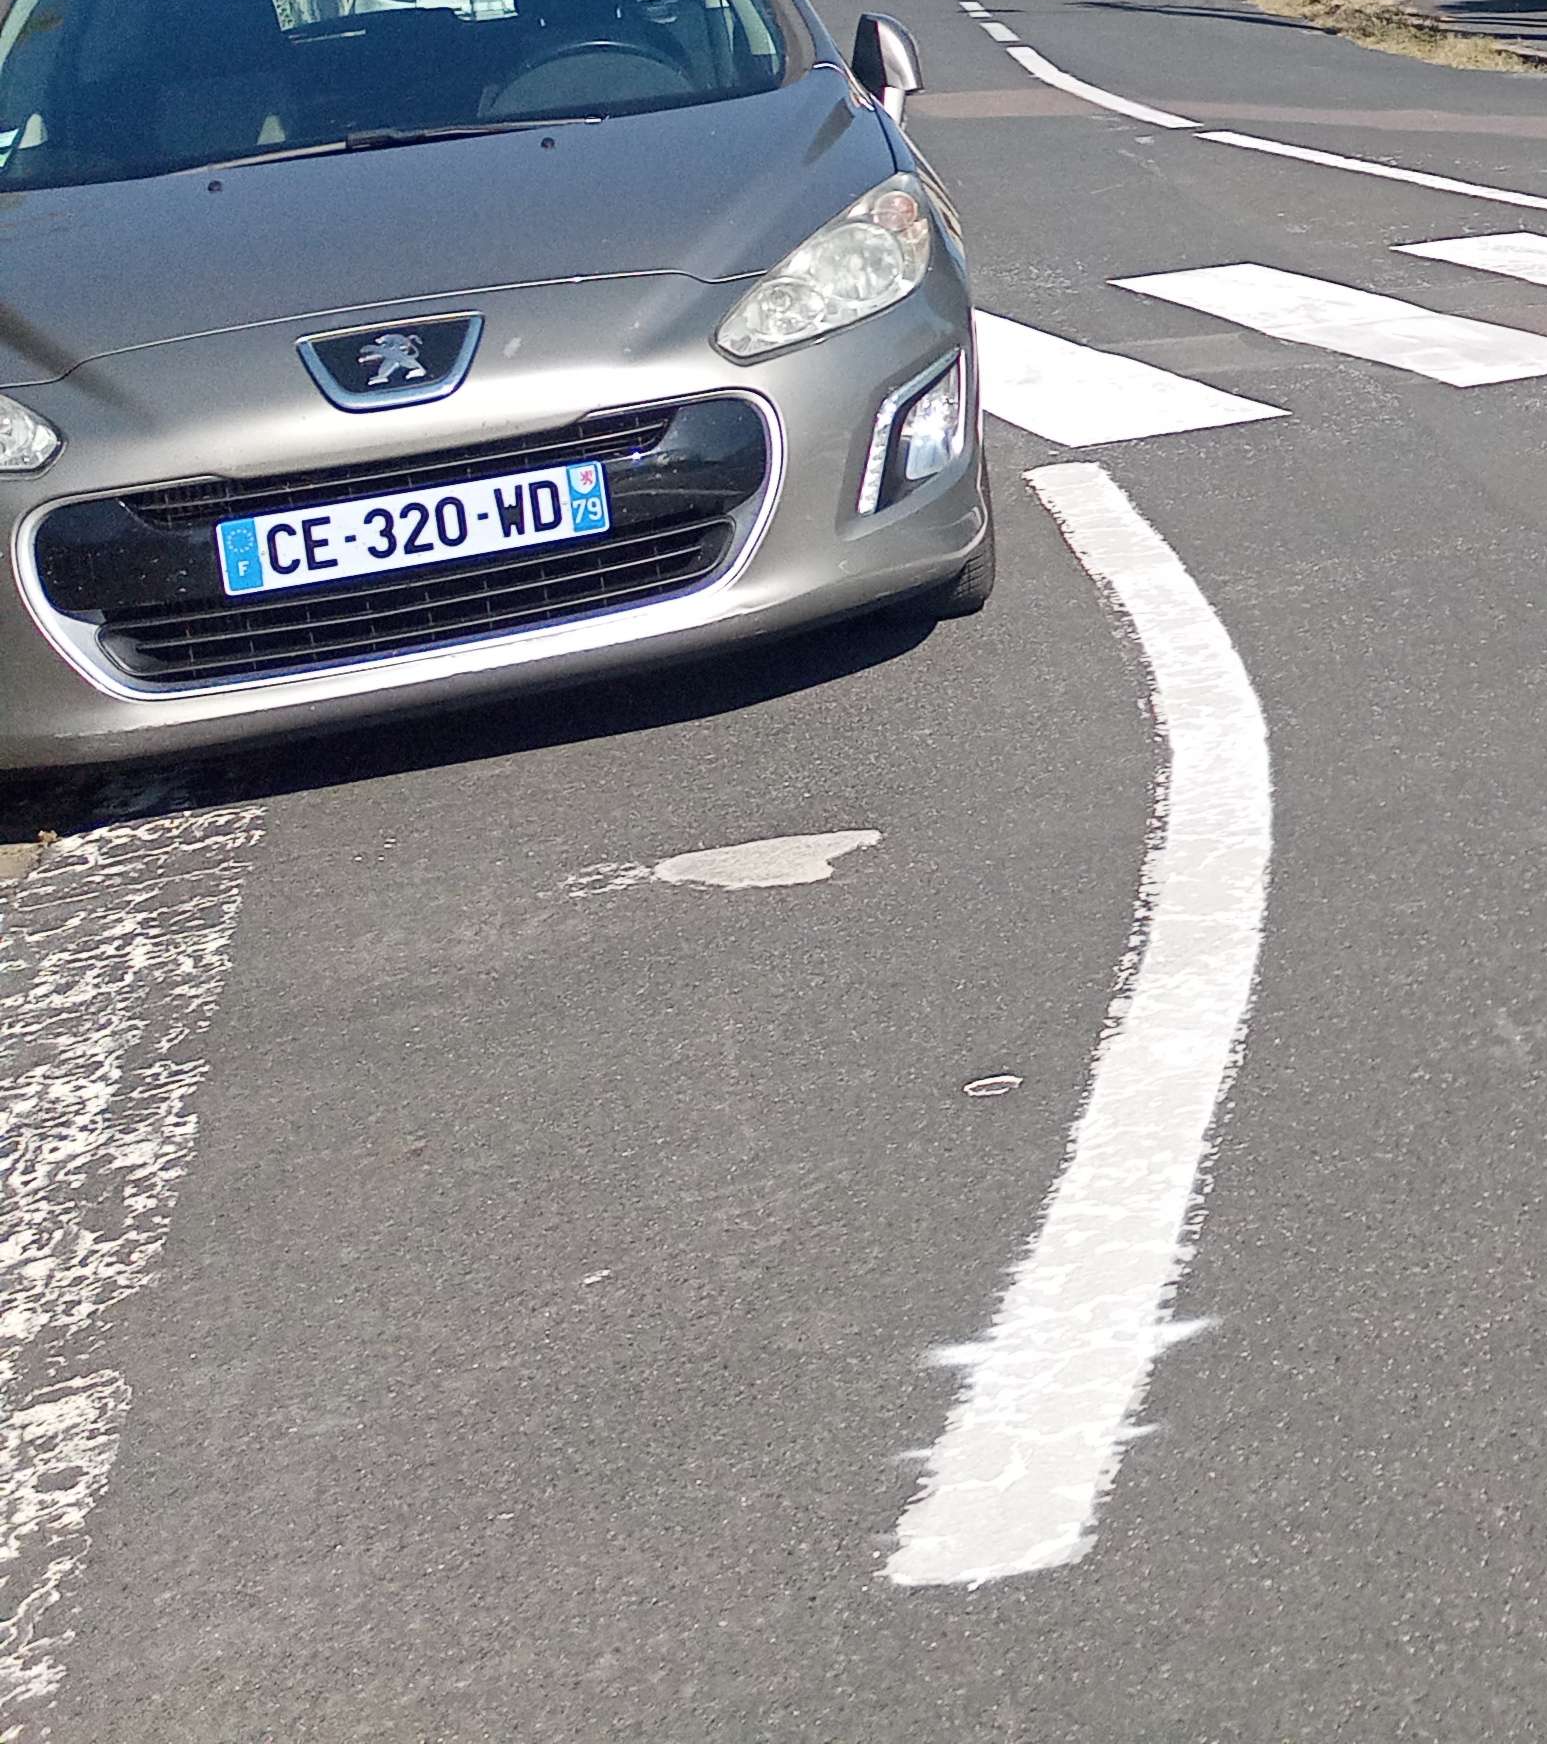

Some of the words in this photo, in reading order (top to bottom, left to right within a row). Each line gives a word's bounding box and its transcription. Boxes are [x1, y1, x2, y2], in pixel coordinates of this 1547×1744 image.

[237, 561, 250, 577] F
[265, 479, 563, 575] CE-320-WD
[571, 498, 603, 524] 79
